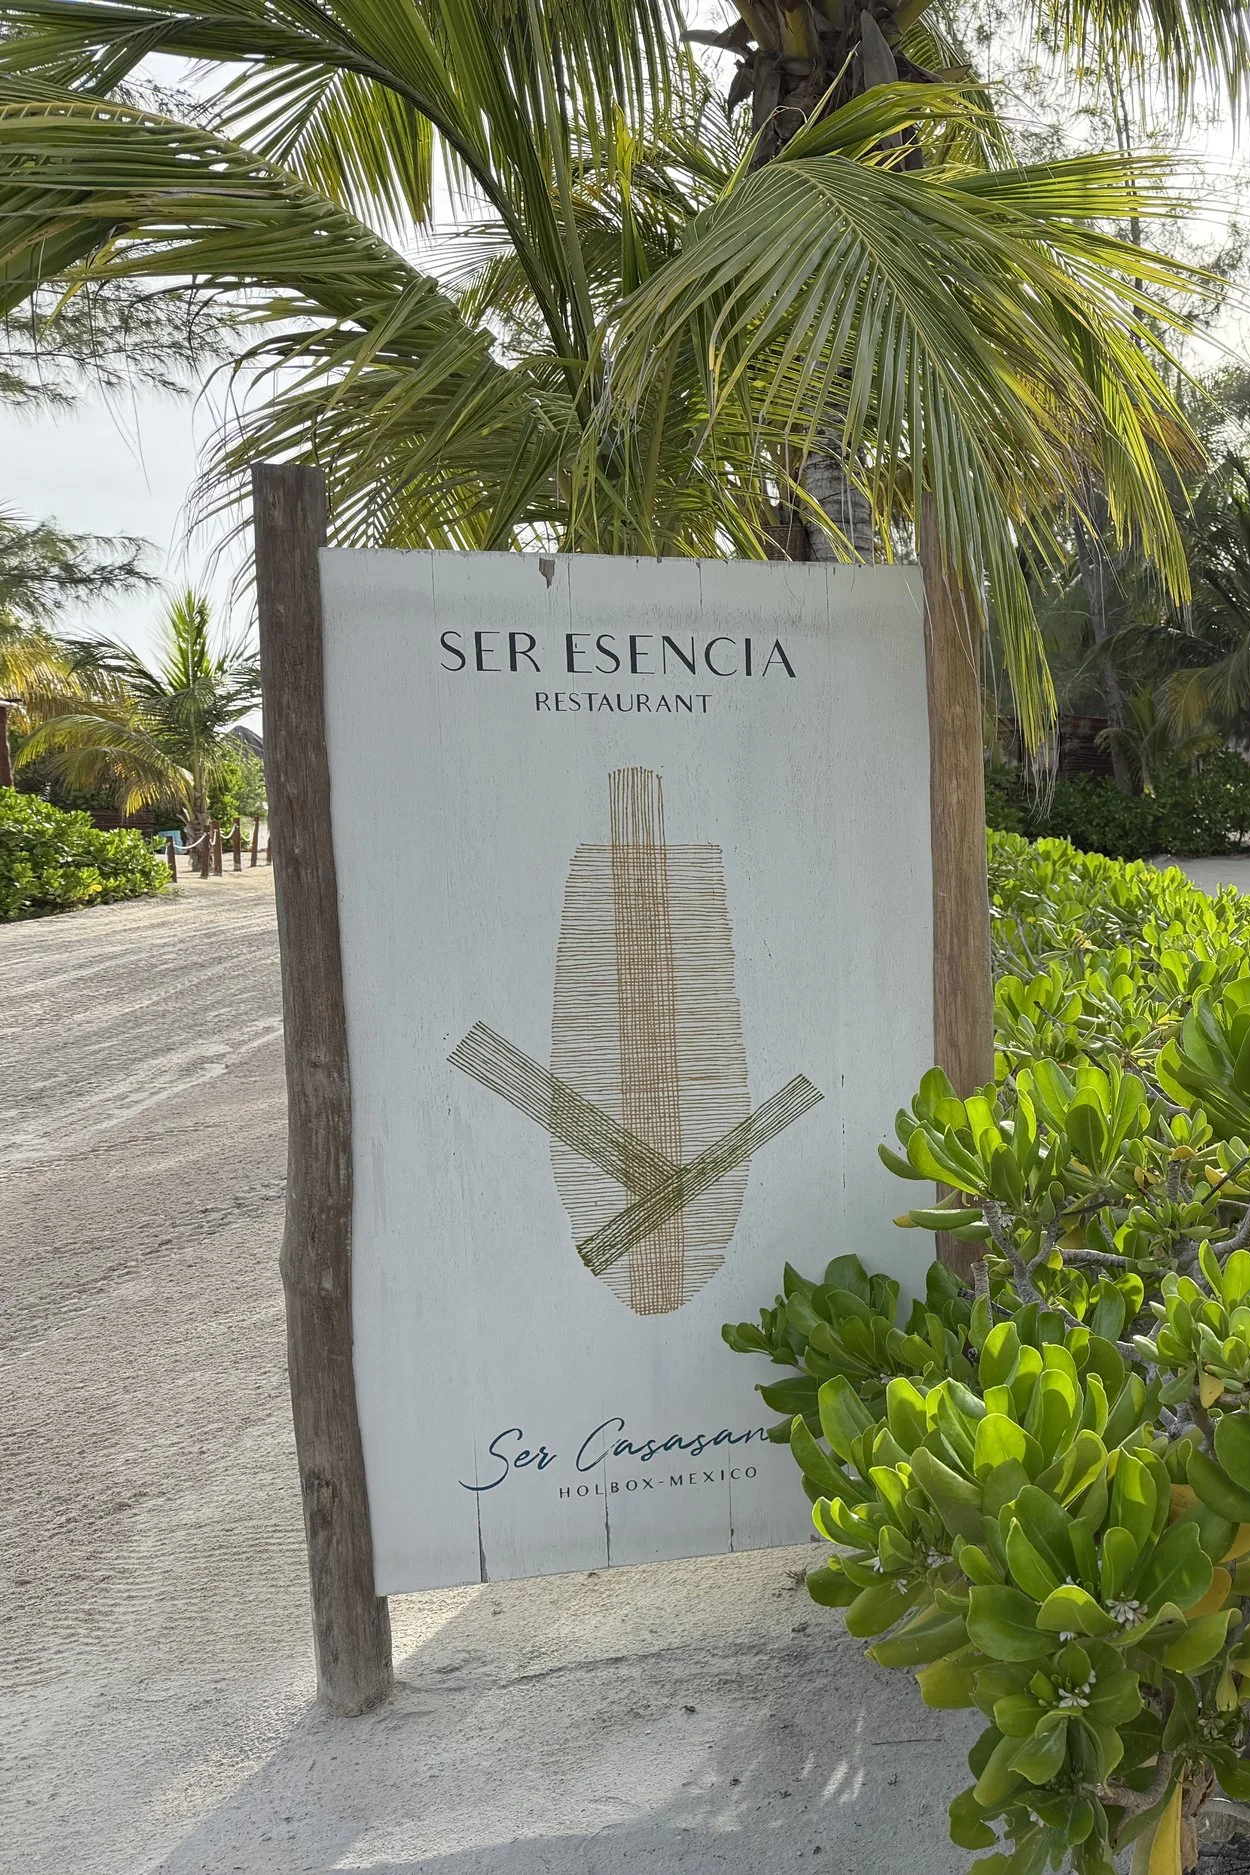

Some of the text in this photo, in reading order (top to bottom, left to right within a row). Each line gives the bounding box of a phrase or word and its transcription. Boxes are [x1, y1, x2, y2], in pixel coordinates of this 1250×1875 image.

[439, 630, 797, 678] SER ESENCIA
[535, 692, 713, 714] RESTAURANT
[458, 1428, 557, 1491] Ser
[559, 1466, 759, 1499] HOLBOX-MEXICO
